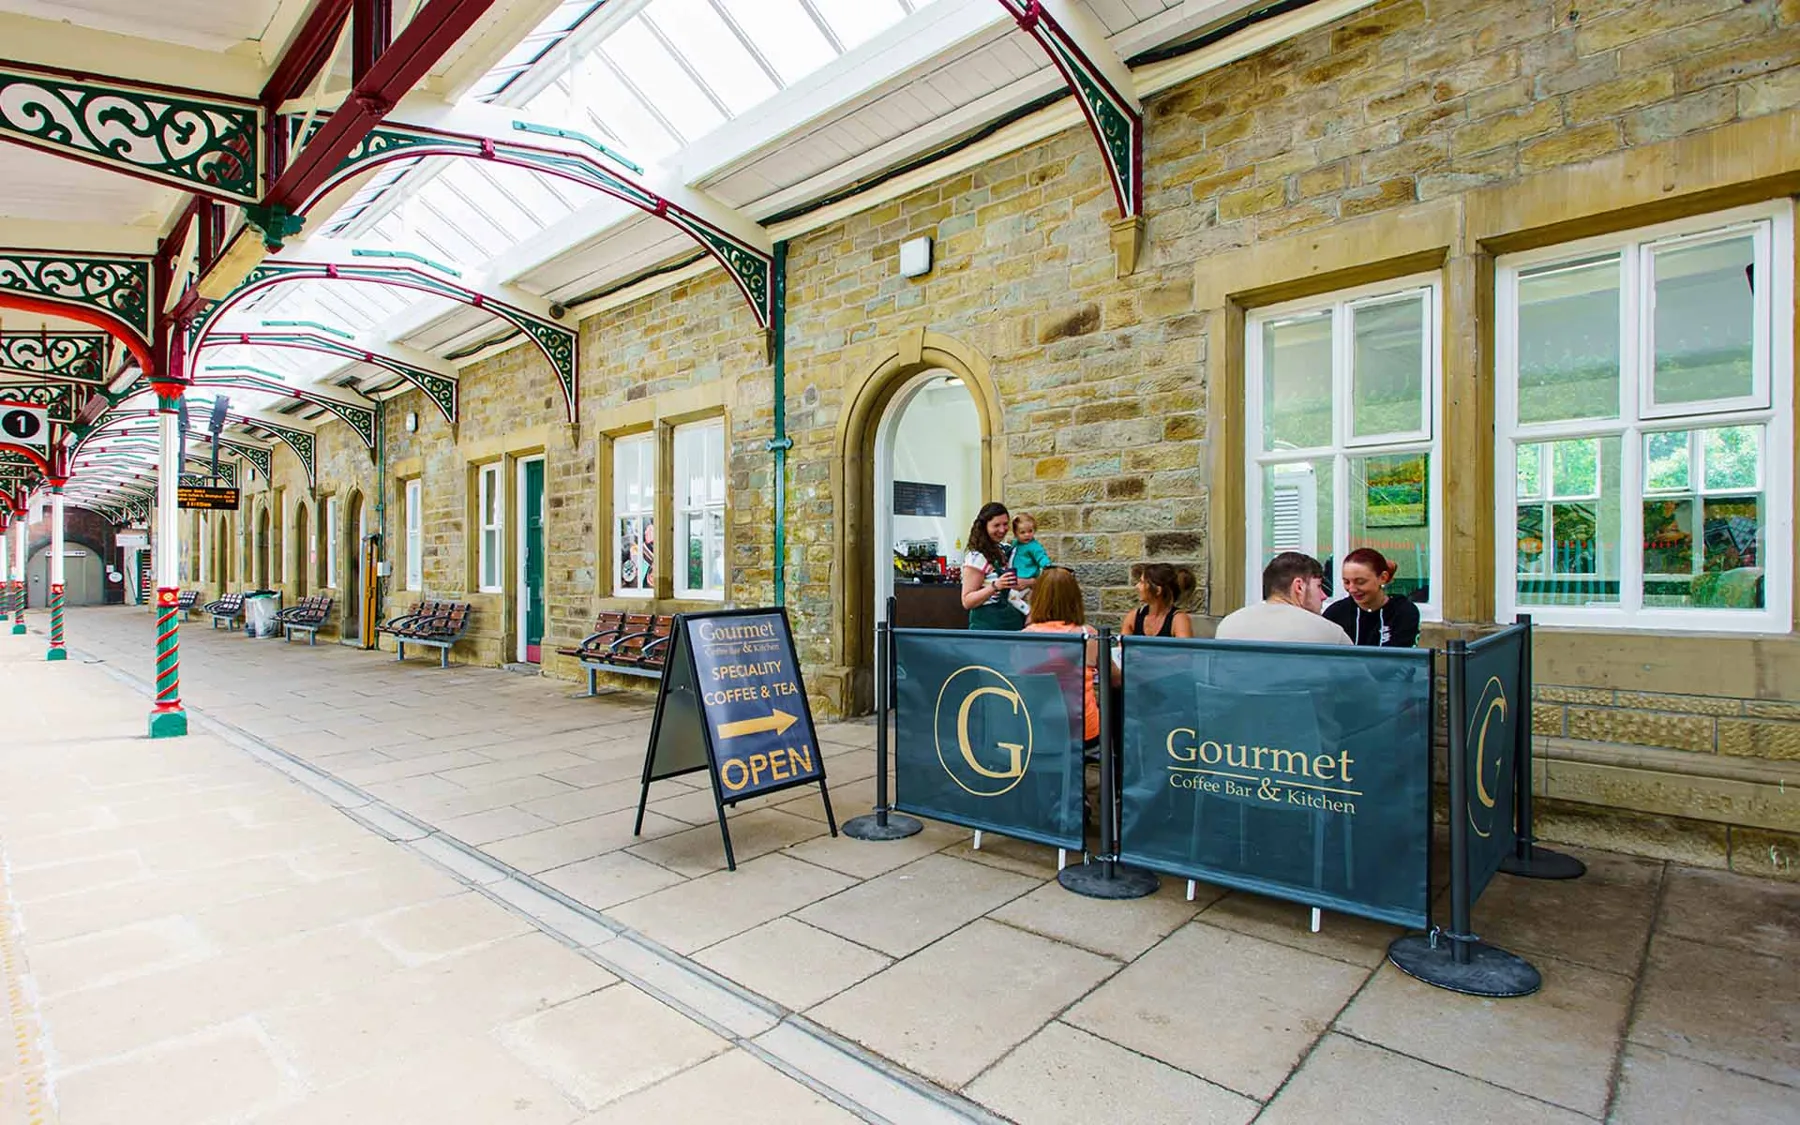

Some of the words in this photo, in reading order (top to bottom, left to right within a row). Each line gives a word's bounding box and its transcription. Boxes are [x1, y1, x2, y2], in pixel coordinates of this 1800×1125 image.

[17, 416, 26, 432] 1
[699, 622, 775, 641] Gourmet
[743, 641, 753, 653] &
[754, 644, 780, 652] Kitchen
[712, 661, 782, 681] SPECIALITY
[704, 687, 758, 706] COFFEE
[761, 684, 771, 698] &
[773, 682, 799, 697] TEA
[957, 687, 1025, 778] G
[1166, 727, 1355, 783] Gourmet
[721, 745, 813, 791] OPEN
[1169, 773, 1221, 793] Coffee
[1225, 781, 1253, 797] Bar
[1257, 777, 1282, 802] &
[1287, 789, 1357, 815] Kitchen
